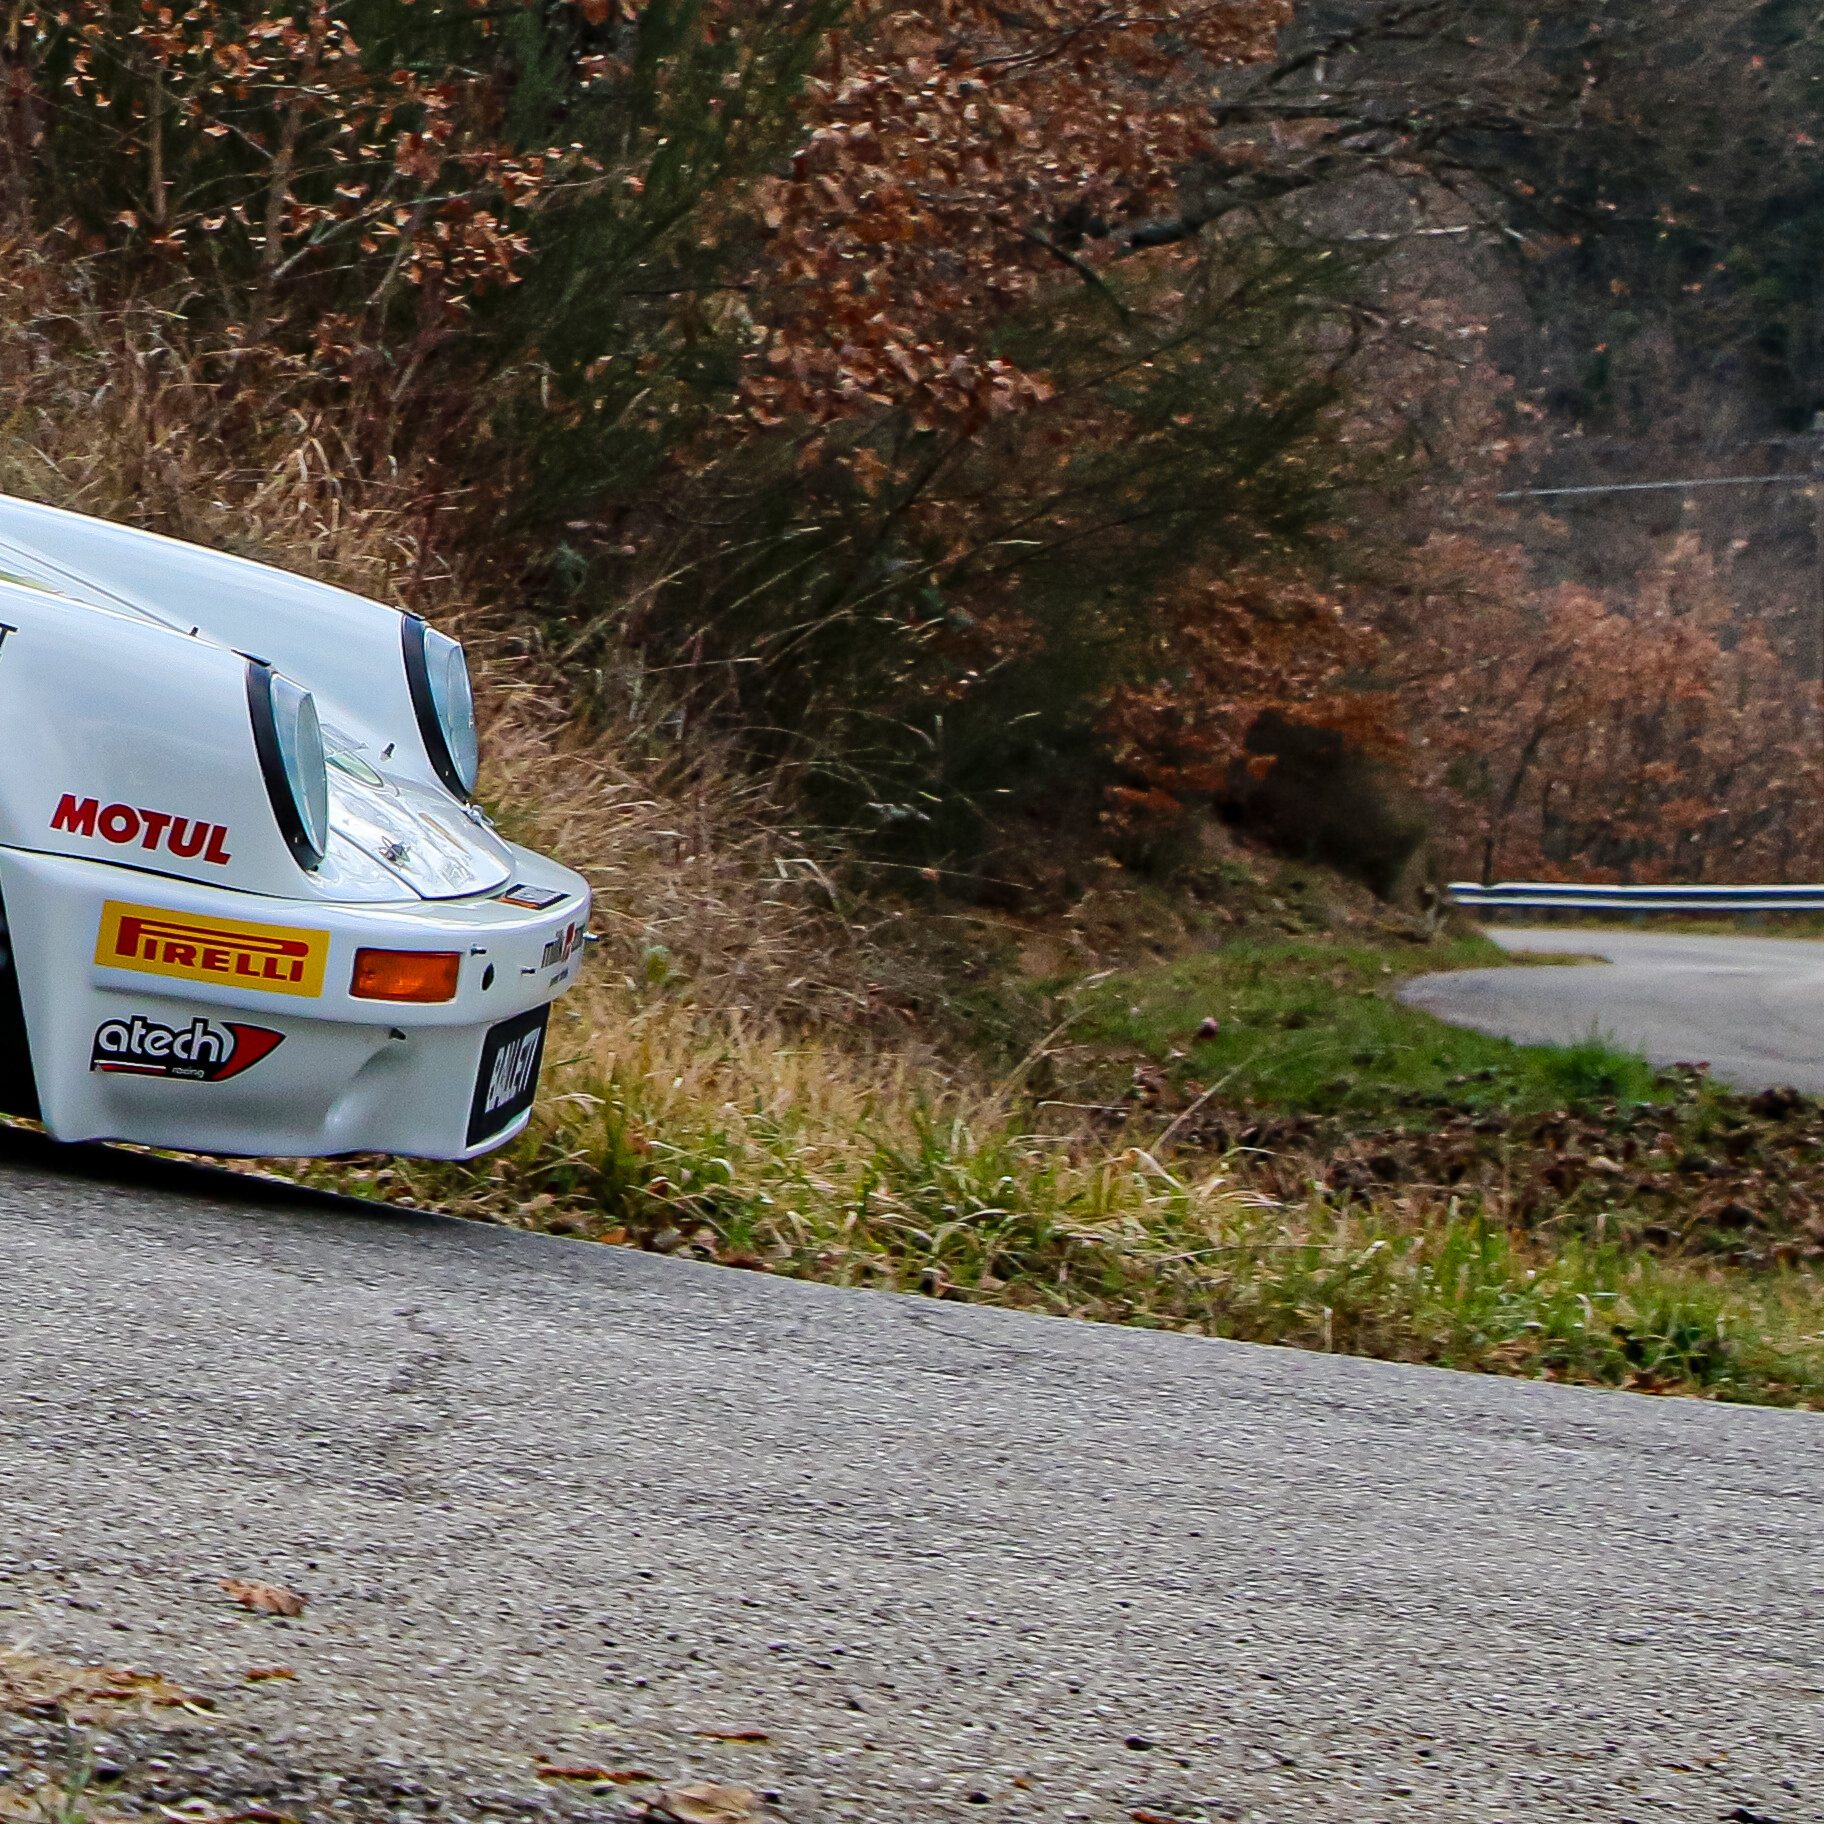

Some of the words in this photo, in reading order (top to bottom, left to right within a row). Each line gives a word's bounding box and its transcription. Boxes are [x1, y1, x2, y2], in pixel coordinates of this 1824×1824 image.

[50, 793, 232, 866] MOTUL
[115, 916, 310, 984] PIRELLI
[98, 1020, 222, 1062] atech
